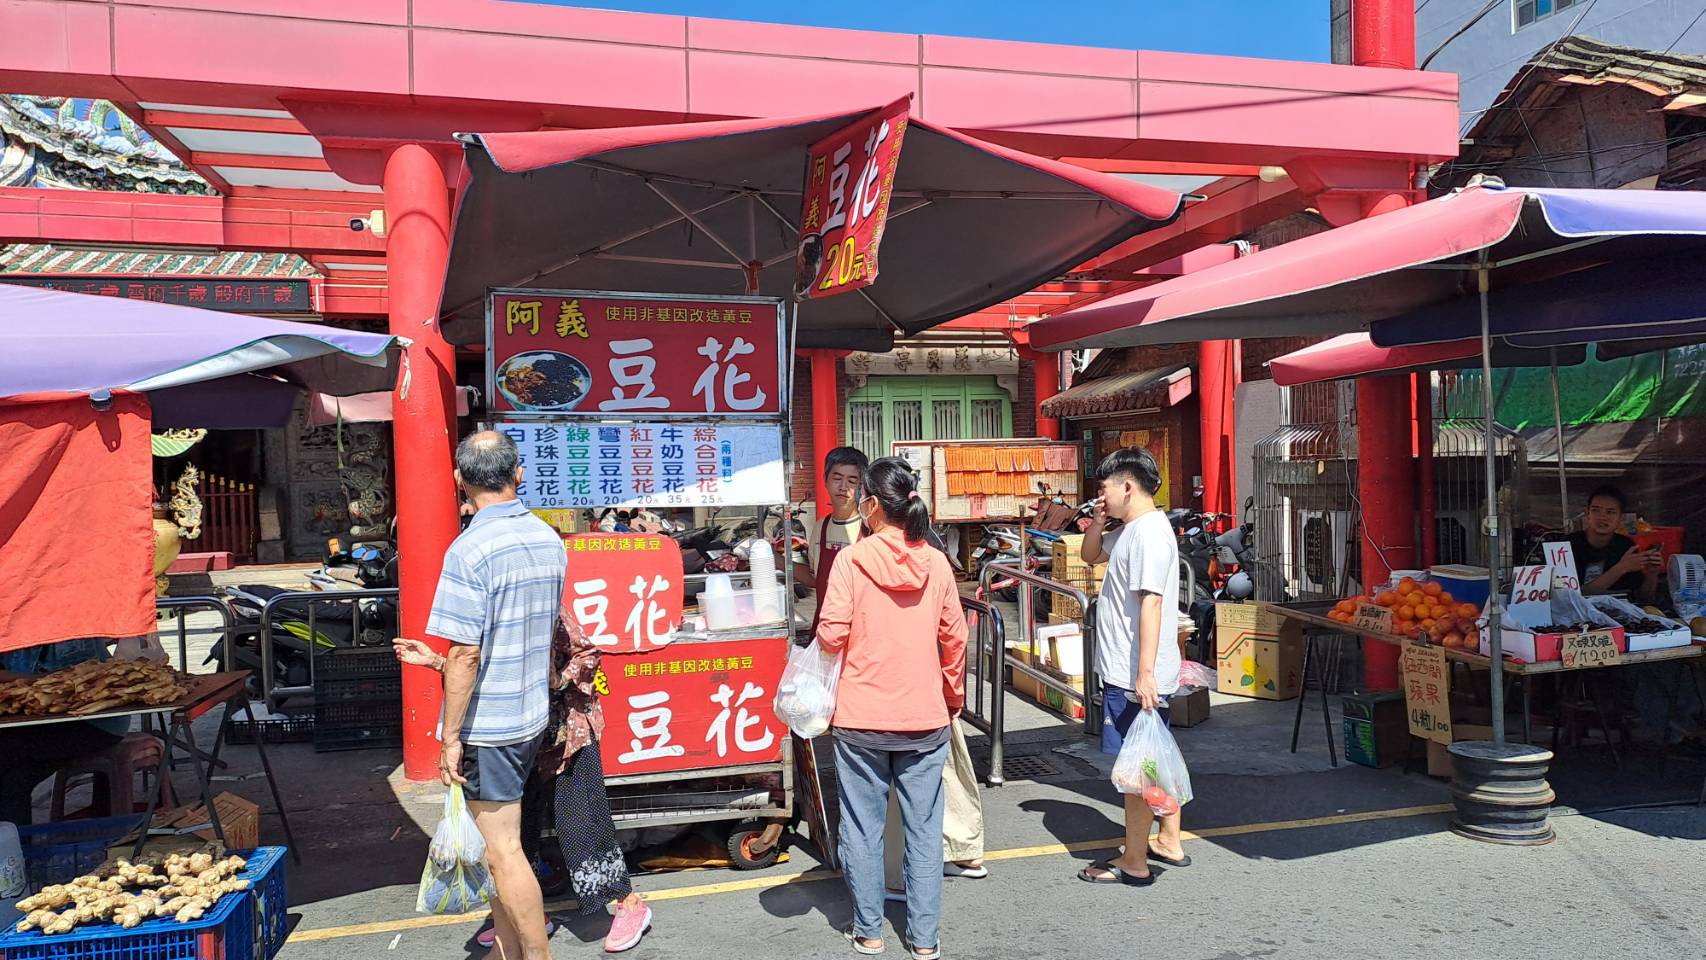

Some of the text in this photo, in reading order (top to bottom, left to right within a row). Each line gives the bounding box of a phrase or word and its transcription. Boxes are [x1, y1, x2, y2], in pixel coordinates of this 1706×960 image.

[804, 154, 828, 230] 阿義
[820, 119, 890, 236] 豆花
[818, 235, 865, 291] 20元
[506, 299, 753, 338] 阿義 使用非基因改造黃豆
[598, 336, 767, 413] 豆花
[534, 427, 559, 495] 珍珠豆花
[566, 427, 592, 495] 綠豆豆花
[630, 427, 655, 494] 紅豆豆花
[660, 427, 685, 494] 牛奶豆花
[694, 427, 718, 494] 綜合豆花
[573, 574, 678, 649] 豆花
[1514, 588, 1549, 605] 200
[623, 656, 754, 678] 使用非基因改造黃豆
[617, 681, 775, 764] 豆花
